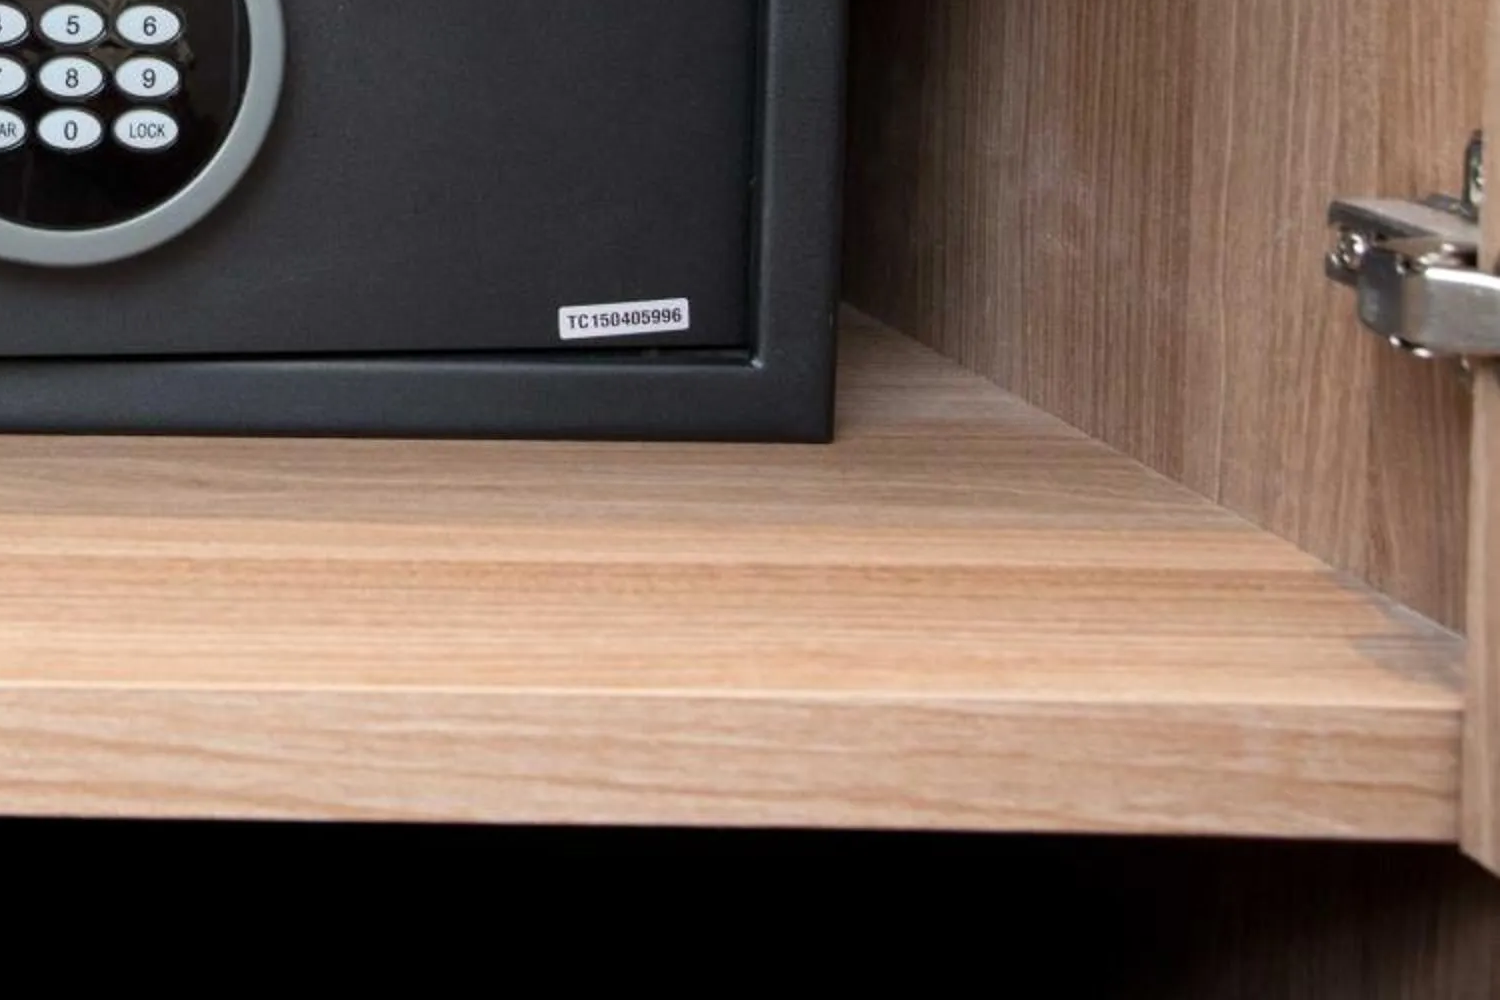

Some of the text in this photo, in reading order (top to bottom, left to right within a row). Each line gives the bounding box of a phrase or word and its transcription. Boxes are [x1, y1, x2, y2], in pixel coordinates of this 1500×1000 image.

[66, 16, 80, 36] 5
[143, 16, 157, 37] 6
[65, 68, 79, 89] 8
[142, 68, 156, 89] 9
[63, 120, 78, 141] 0
[129, 123, 165, 138] LOCK
[566, 308, 682, 329] TC150405996
